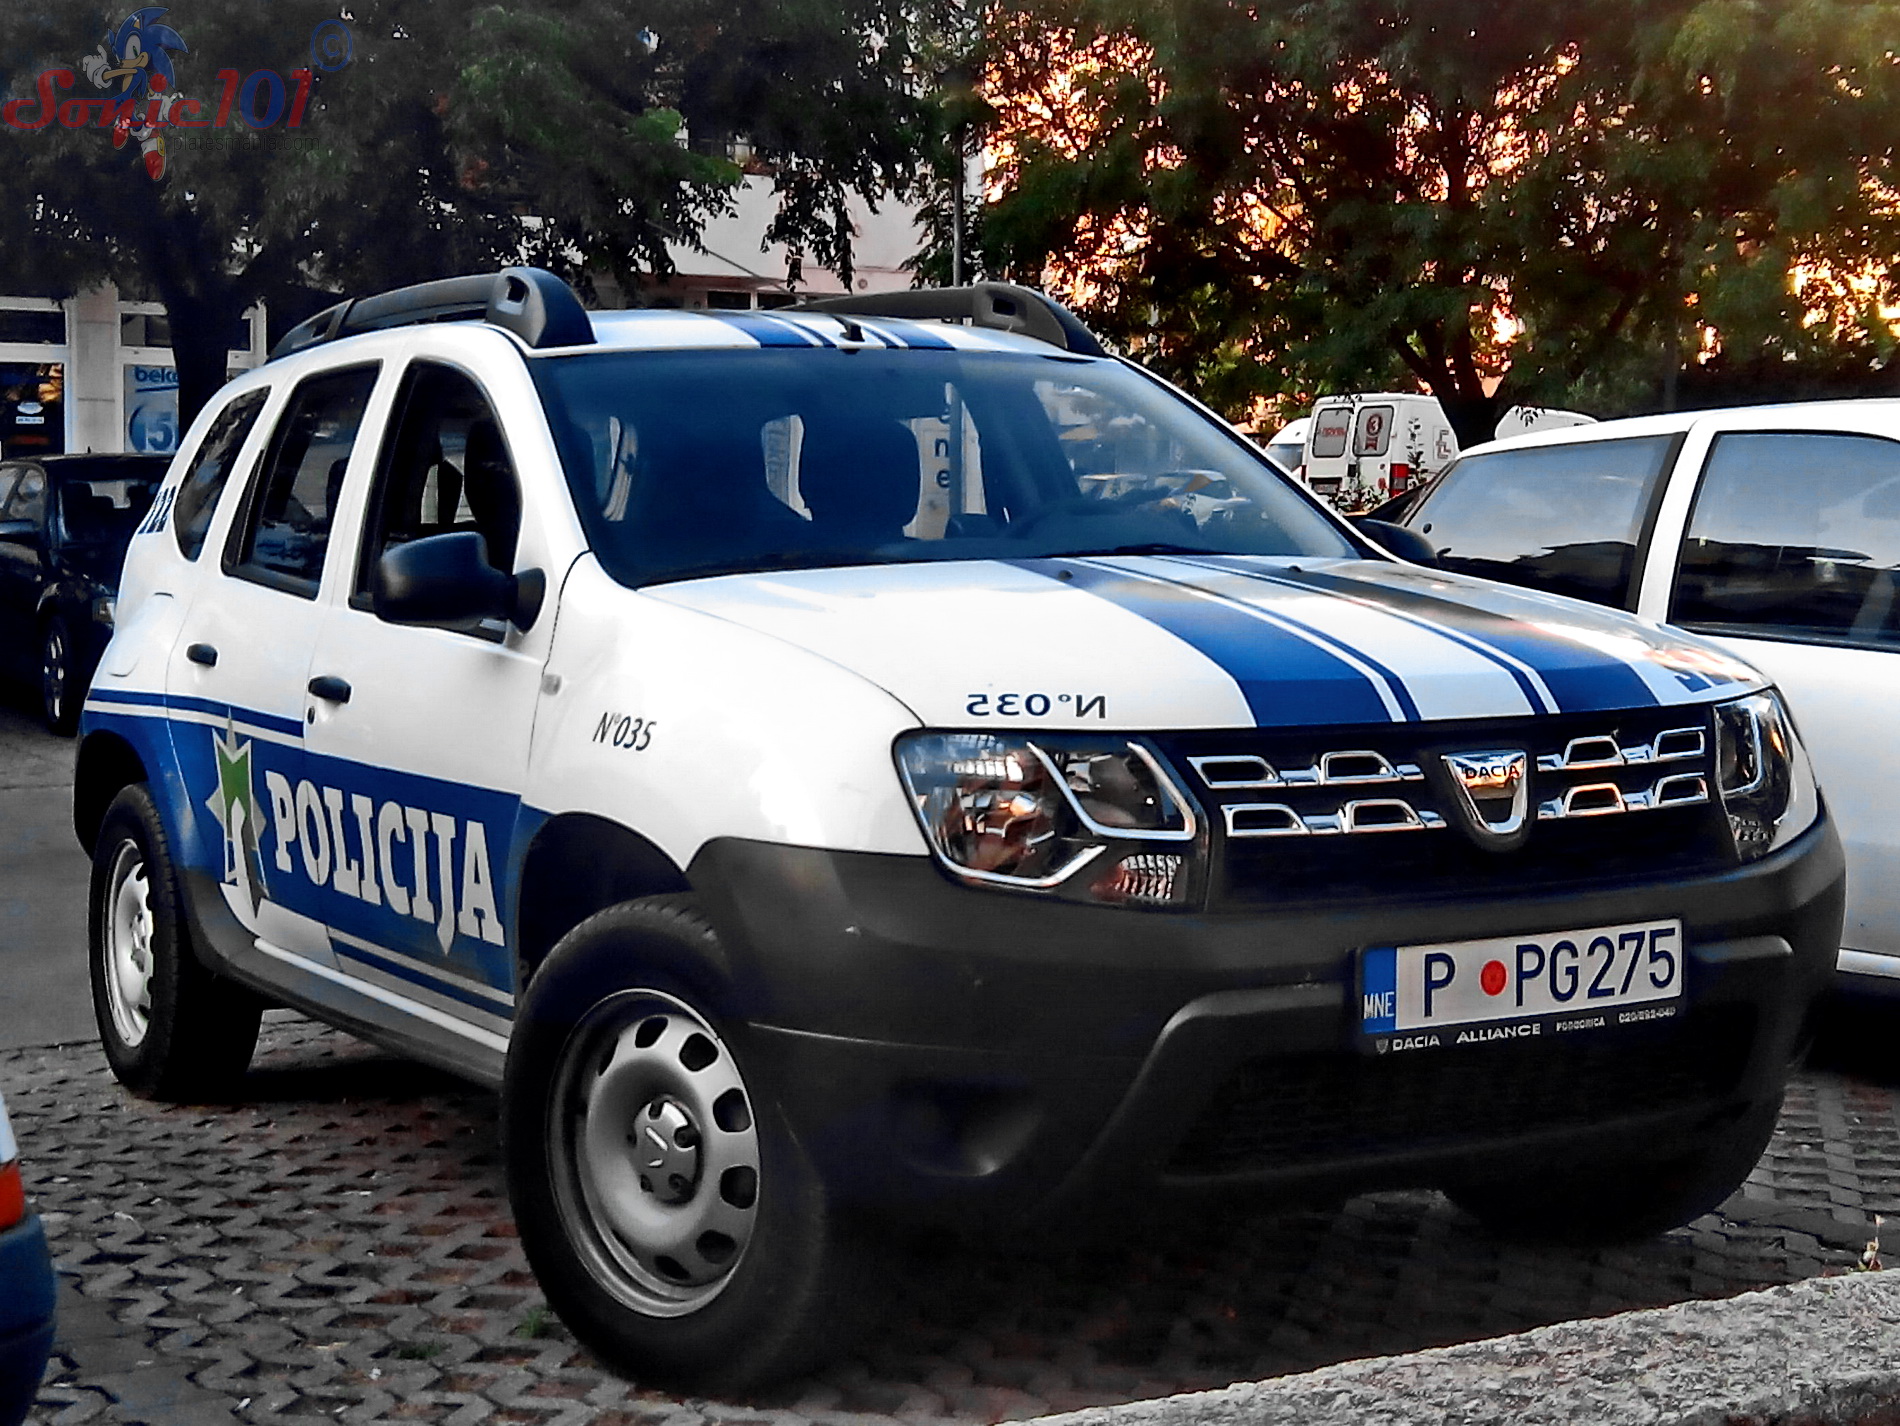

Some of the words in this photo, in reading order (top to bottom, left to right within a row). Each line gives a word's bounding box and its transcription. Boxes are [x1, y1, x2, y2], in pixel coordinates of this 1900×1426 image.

[1465, 765, 1519, 779] DACIA
[266, 770, 505, 956] POLICIJA
[1424, 953, 1456, 1018] P
[1515, 927, 1677, 1007] PG275
[1363, 992, 1395, 1020] MNE
[1393, 1034, 1440, 1051] DACIA
[1456, 1023, 1541, 1044] ALLIANCE
